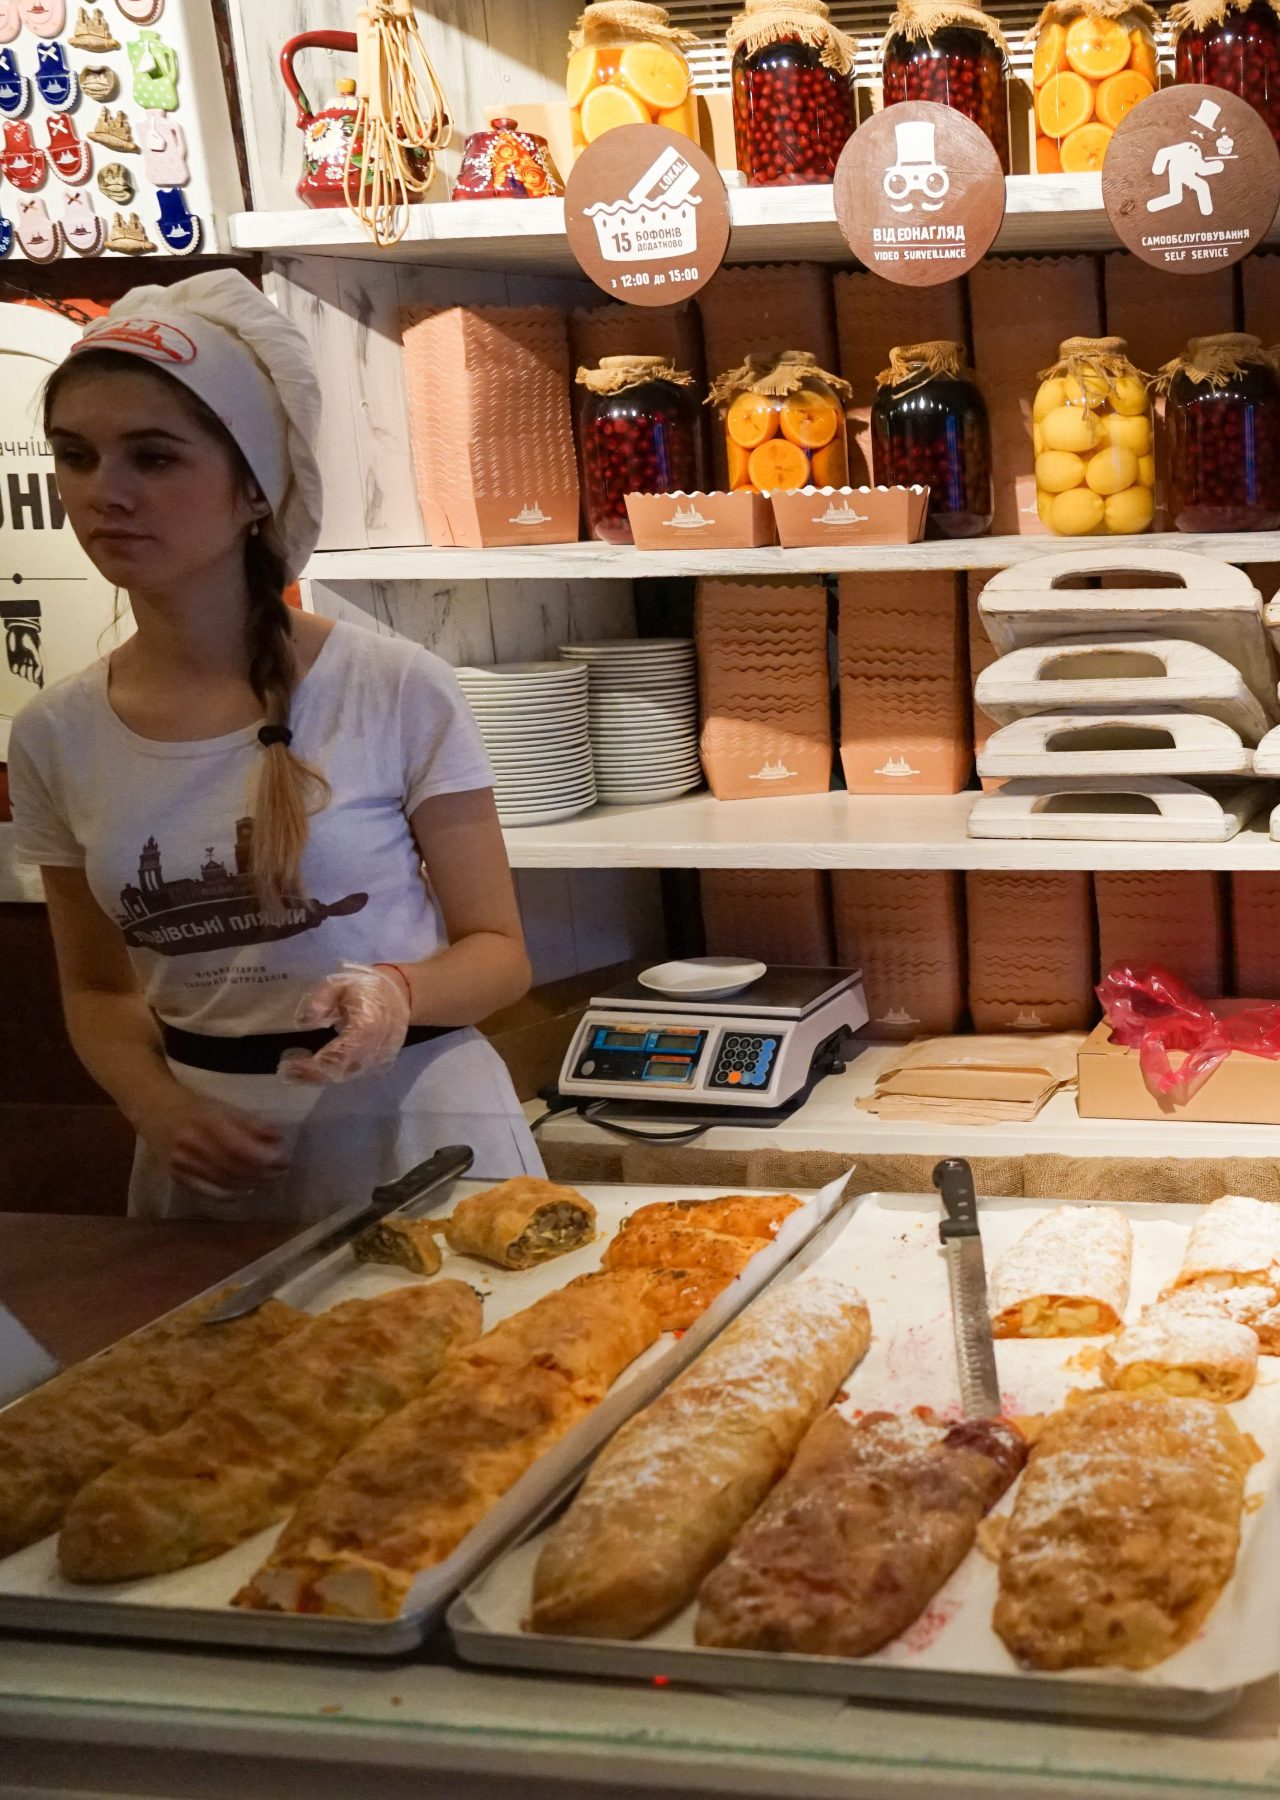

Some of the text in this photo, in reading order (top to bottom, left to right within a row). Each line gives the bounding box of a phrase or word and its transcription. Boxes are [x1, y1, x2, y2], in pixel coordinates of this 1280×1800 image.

[658, 158, 687, 192] LOKAL
[612, 232, 632, 253] 15
[873, 225, 966, 243] ВІДЕОНАГЛЯД
[1141, 228, 1250, 246] САМООБСЛУГОВУВАННЯ
[637, 239, 683, 252] ДОДАТКОВО
[874, 248, 967, 261] VIDEO SURVEILLANCE
[1164, 247, 1229, 261] SELF SERVICE
[620, 272, 650, 287] 12:00
[668, 267, 699, 282] 15:00
